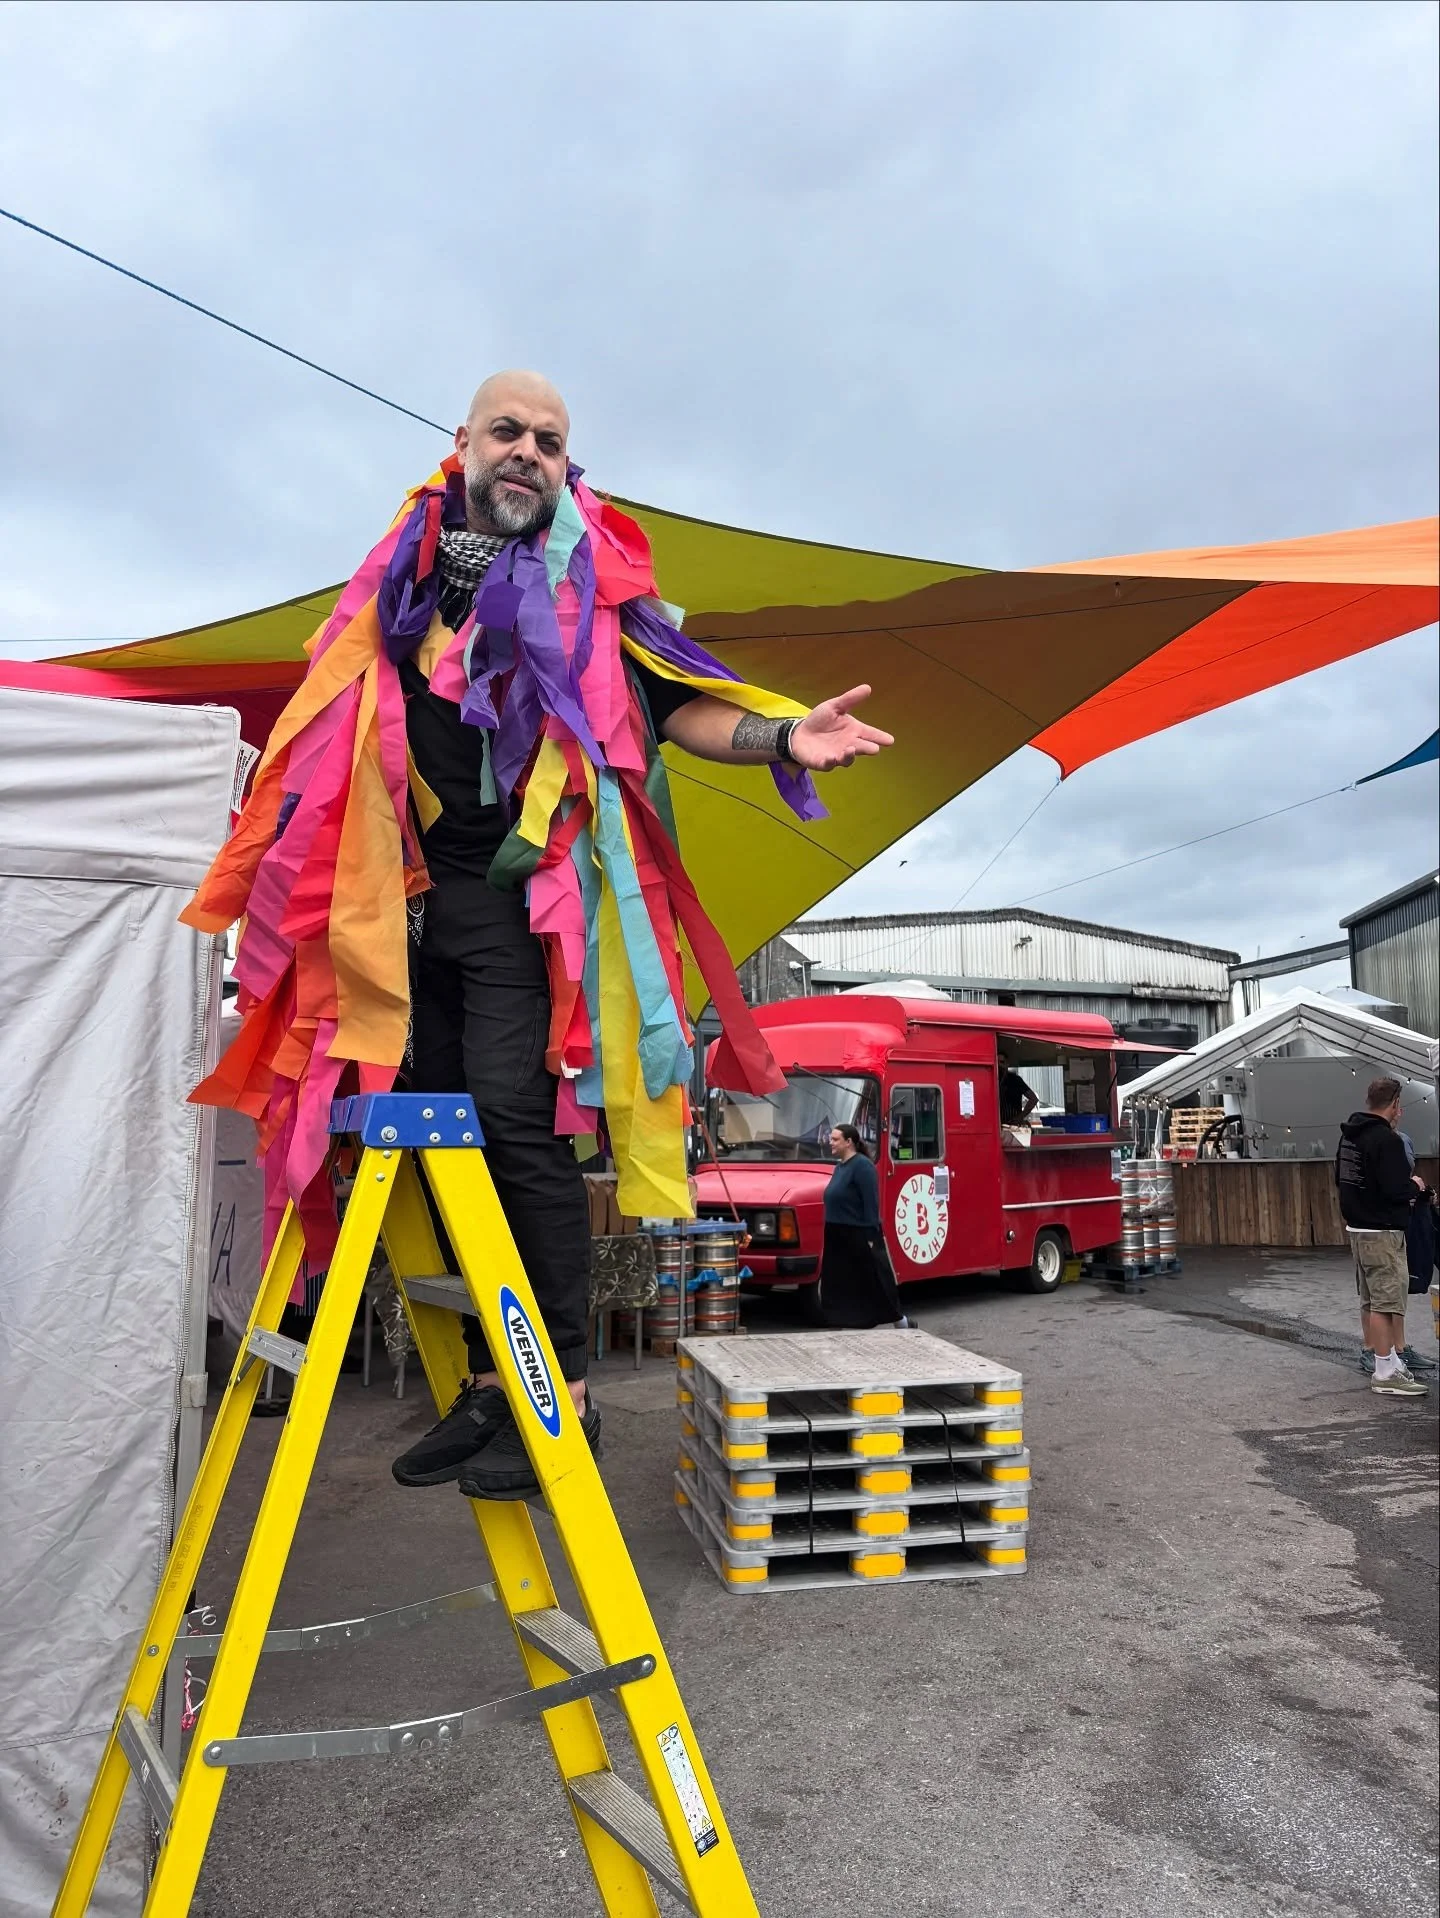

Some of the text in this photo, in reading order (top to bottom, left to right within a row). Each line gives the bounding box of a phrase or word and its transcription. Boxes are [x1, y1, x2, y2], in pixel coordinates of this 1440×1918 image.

[897, 1194, 919, 1259] BOCCA
[911, 1176, 922, 1194] DI
[928, 1182, 947, 1258] BANCHI
[916, 1203, 929, 1235] B
[510, 1316, 552, 1408] WERNER
